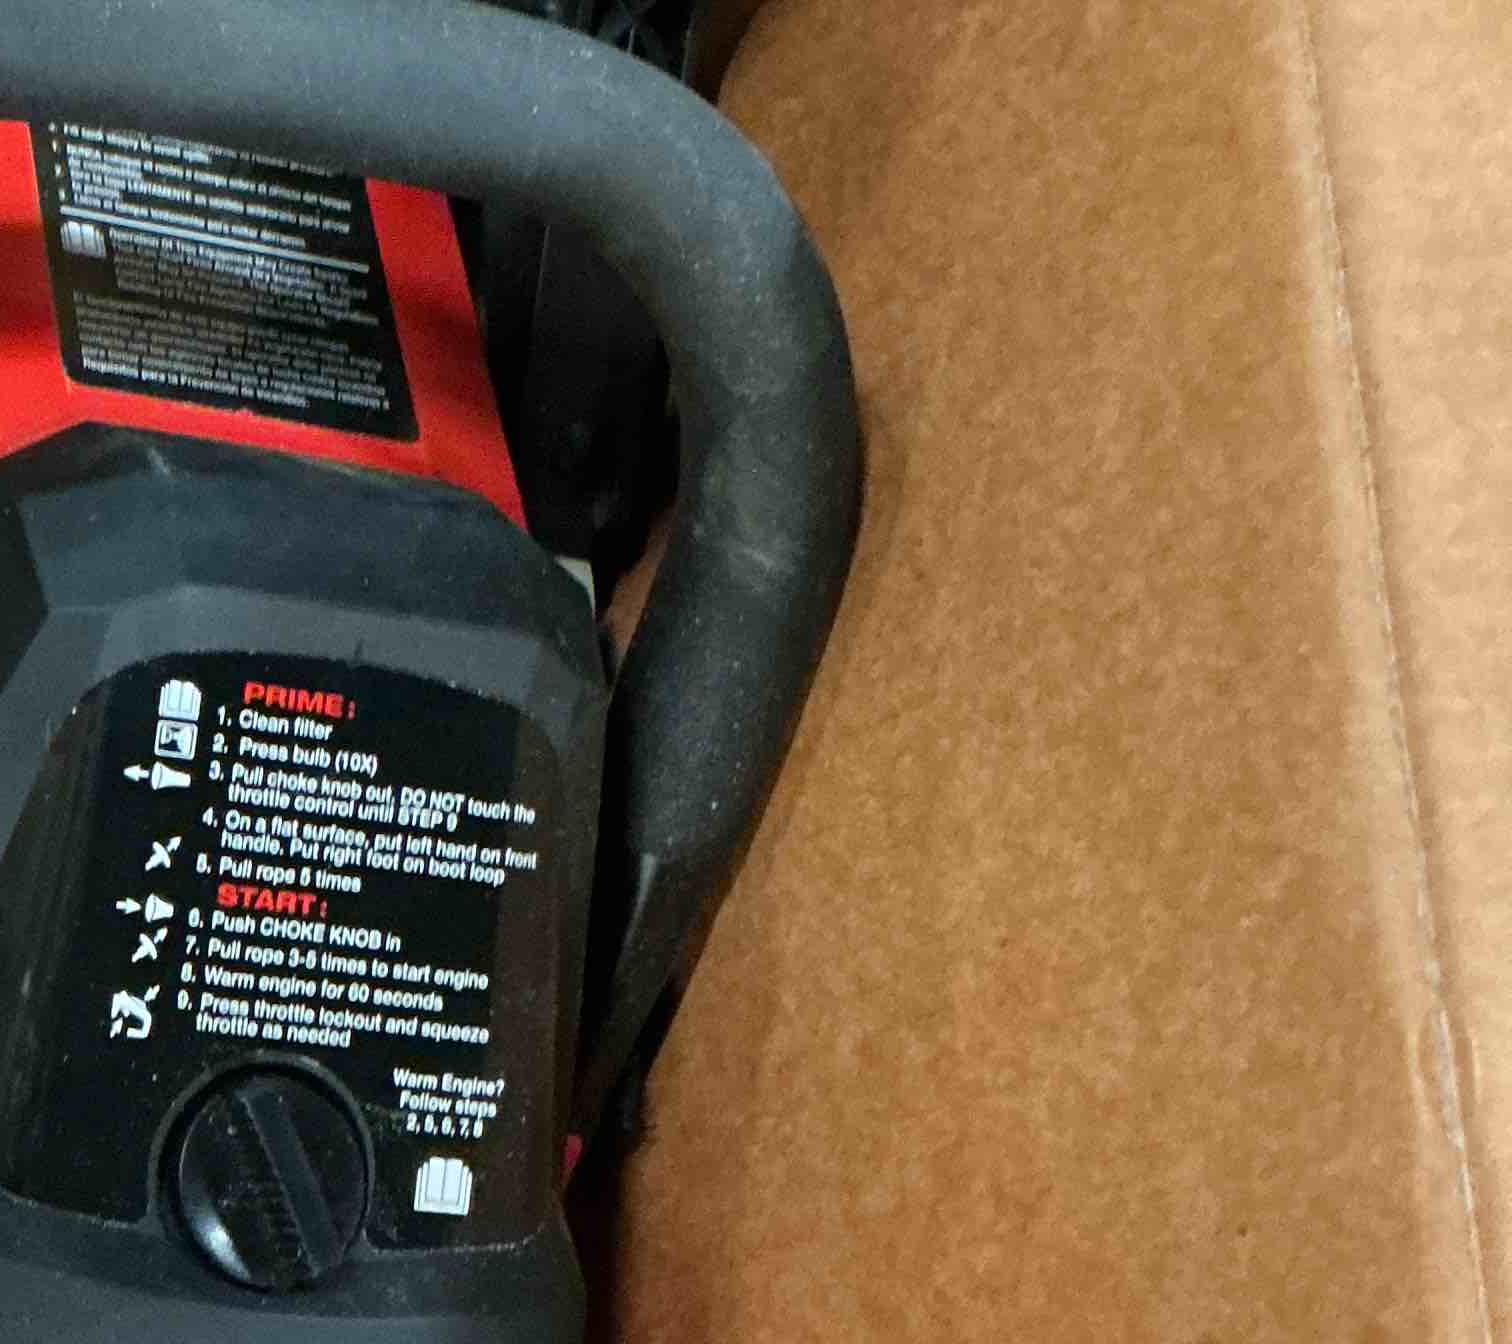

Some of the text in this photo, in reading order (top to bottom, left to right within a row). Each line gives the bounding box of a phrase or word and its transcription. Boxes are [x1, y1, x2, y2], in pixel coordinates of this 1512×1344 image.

[217, 705, 332, 740] 1. Clean filter
[212, 732, 377, 778] 2. Press bulb (10X)
[208, 759, 223, 780] 3.
[231, 762, 263, 785] Pull
[266, 769, 317, 793] choke
[320, 775, 362, 800] knob
[400, 786, 426, 810] DO
[427, 790, 464, 814] NOT
[467, 797, 510, 820] touch
[513, 803, 535, 824] the
[228, 783, 290, 808] throttle
[293, 795, 354, 817] control
[357, 803, 394, 823] until
[397, 806, 443, 828] STEP
[202, 807, 217, 827] 4.
[225, 809, 250, 830] On
[254, 817, 266, 834] a
[267, 815, 298, 839] flat
[371, 833, 402, 855] put
[405, 835, 432, 856] left
[435, 838, 476, 861] hand
[479, 847, 501, 864] on
[504, 847, 536, 869] front
[219, 855, 252, 878] Pull
[255, 864, 295, 885] rope
[315, 869, 361, 892] times
[289, 838, 319, 859] Put
[323, 844, 361, 867] right
[366, 849, 399, 870] foot
[402, 856, 424, 873] on
[428, 857, 466, 879] boot
[469, 862, 505, 887] loop
[211, 910, 255, 934] Push
[259, 916, 325, 942] CHOKE
[329, 924, 381, 949] KNOB
[385, 932, 400, 952] in
[185, 935, 199, 954] 7.
[207, 937, 241, 959] Pull
[244, 946, 284, 967] rope
[321, 951, 366, 975] times
[371, 958, 388, 977] to
[392, 962, 430, 982] start
[433, 969, 488, 990] engine
[204, 964, 254, 989] Warm
[258, 975, 316, 997] engine
[320, 978, 345, 999] for
[373, 988, 443, 1011] seconds
[196, 1011, 351, 1047] throttle as needed
[199, 992, 249, 1016] Press
[254, 999, 314, 1024] throttle
[318, 1006, 381, 1031] lockout
[385, 1017, 417, 1035] and
[421, 1021, 489, 1043] squeeze
[393, 1067, 504, 1099] Warm Engine?
[399, 1089, 452, 1112] Follow
